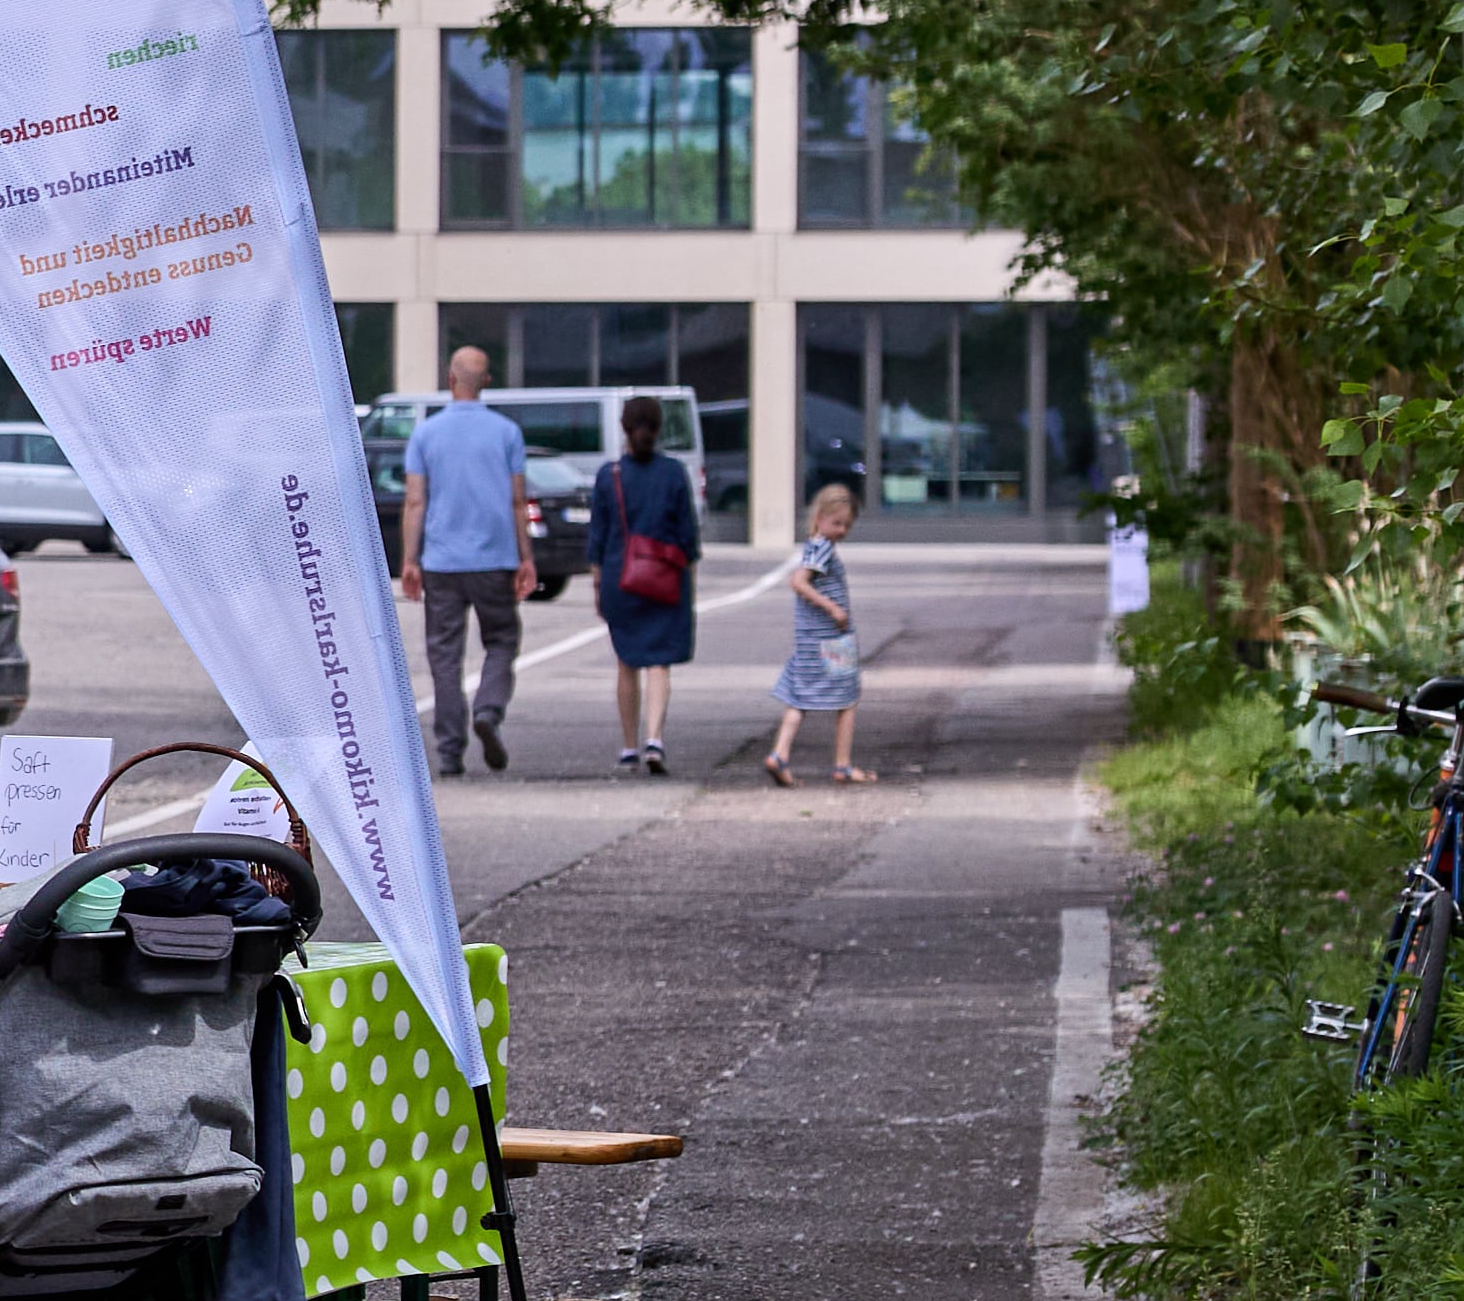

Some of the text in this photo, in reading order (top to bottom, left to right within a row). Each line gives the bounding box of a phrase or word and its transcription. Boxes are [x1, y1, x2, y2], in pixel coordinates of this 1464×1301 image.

[11, 747, 50, 774] Saft
[5, 783, 61, 807] pressen
[0, 815, 21, 834] für
